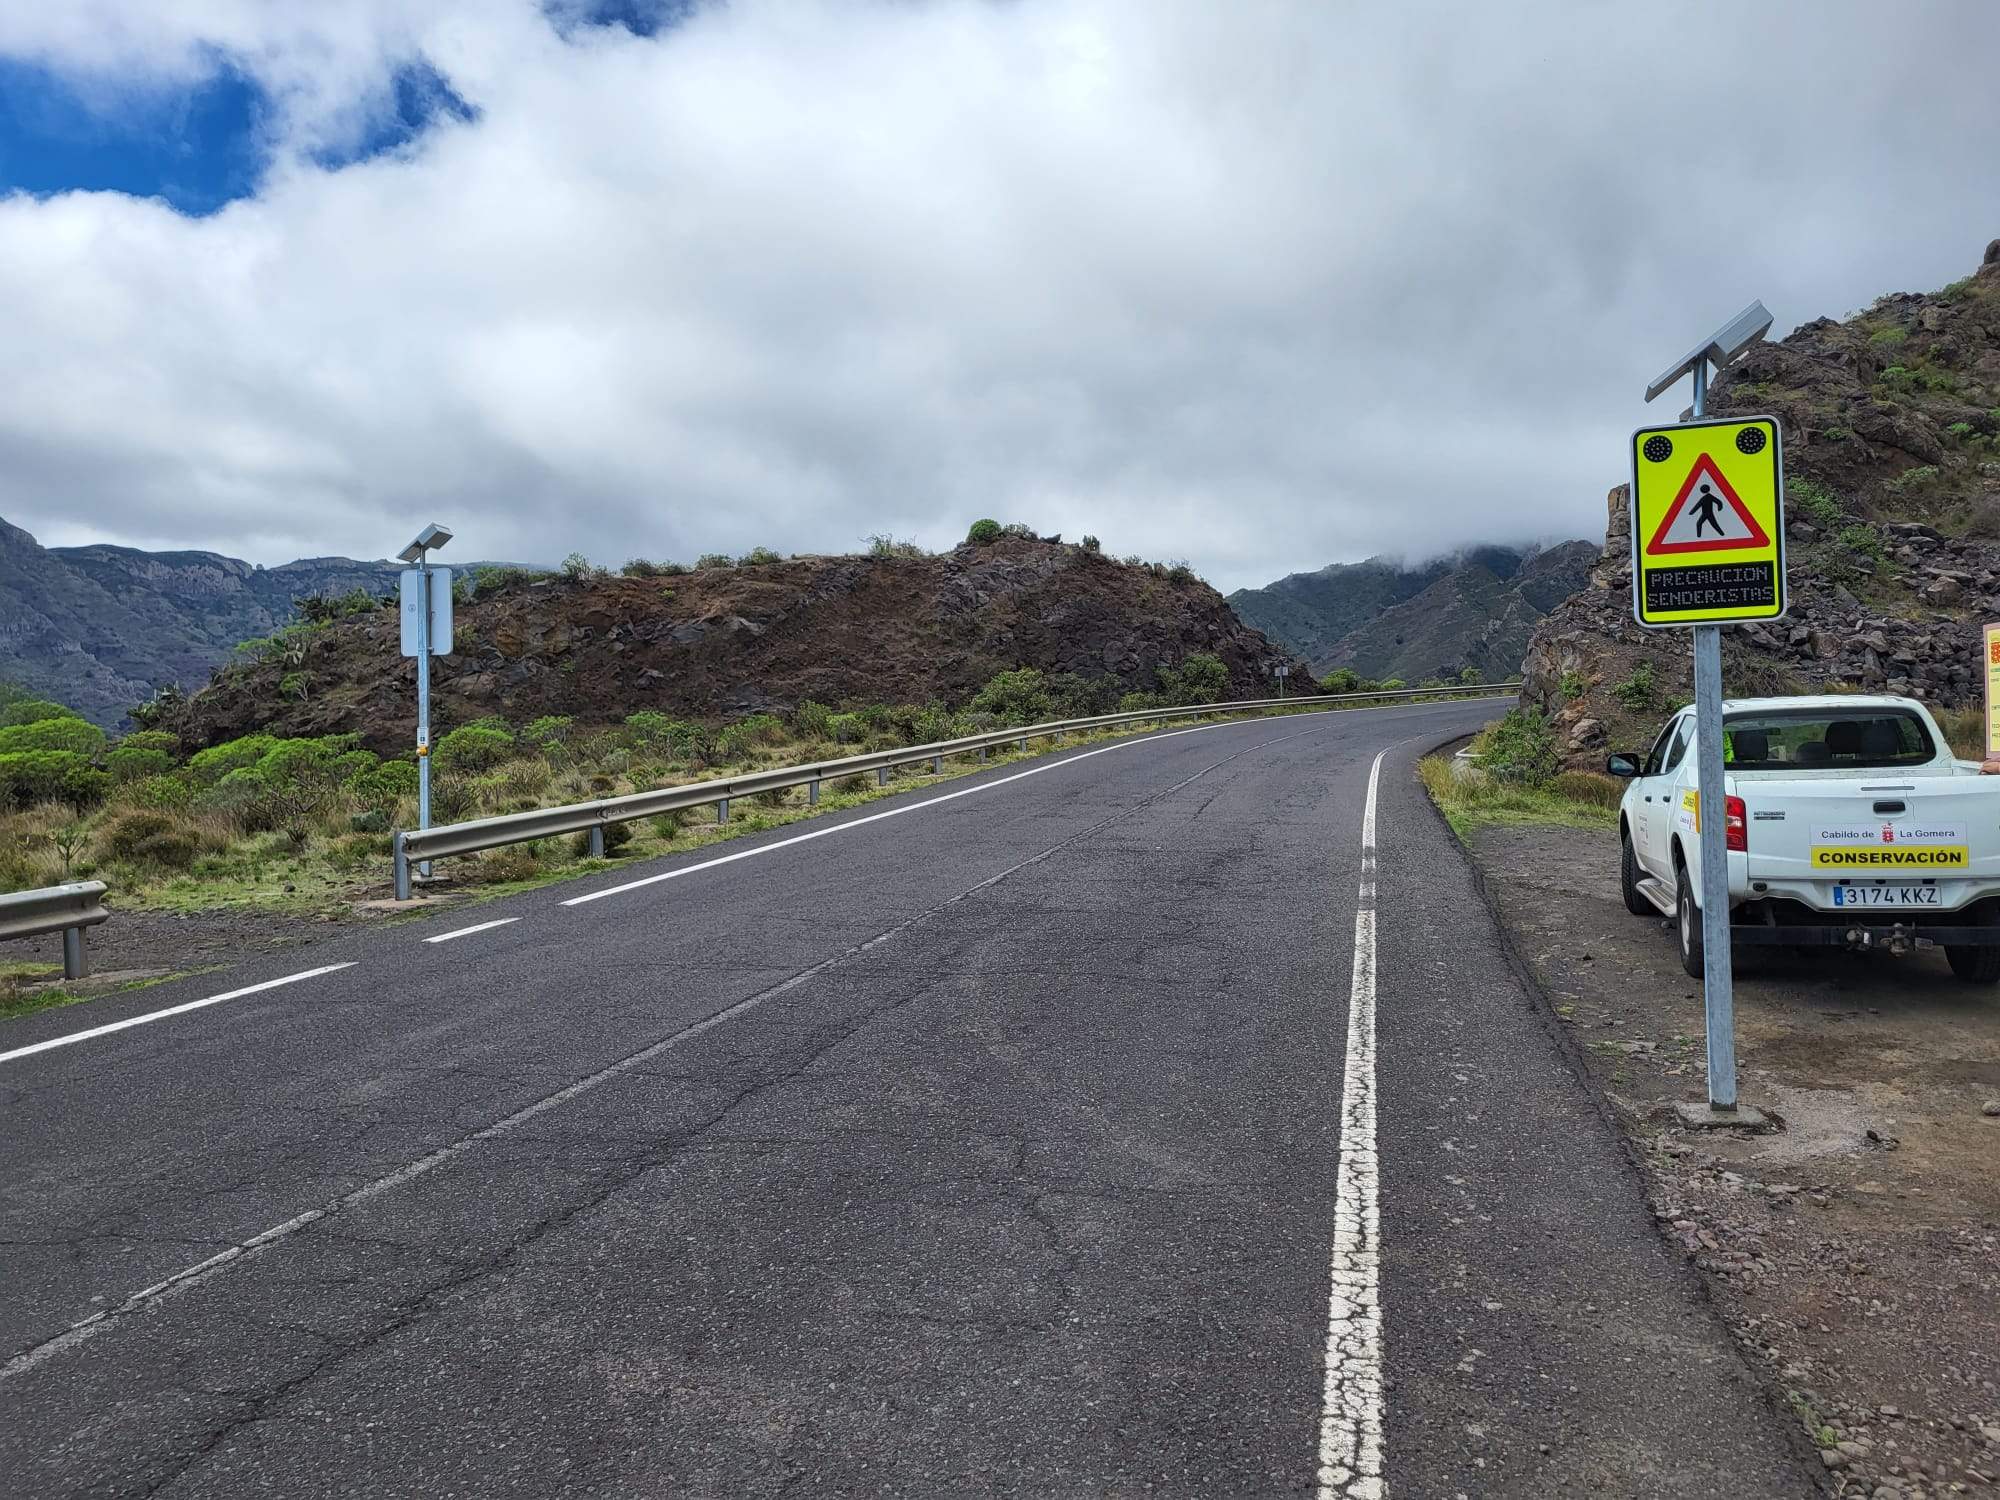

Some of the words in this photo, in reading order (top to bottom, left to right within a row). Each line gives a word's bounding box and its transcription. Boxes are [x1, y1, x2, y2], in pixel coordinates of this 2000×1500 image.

[1651, 566, 1768, 587] PRECAUCION
[1648, 586, 1774, 607] SENDERISTAS
[1821, 830, 1859, 839] Cabildo
[1862, 830, 1875, 839] de
[1900, 830, 1913, 838] La
[1915, 829, 1955, 838] Gomera
[1819, 850, 1962, 864] CONSERVACIÓN
[1847, 888, 1893, 904] 3174
[1900, 887, 1938, 904] KKZ
